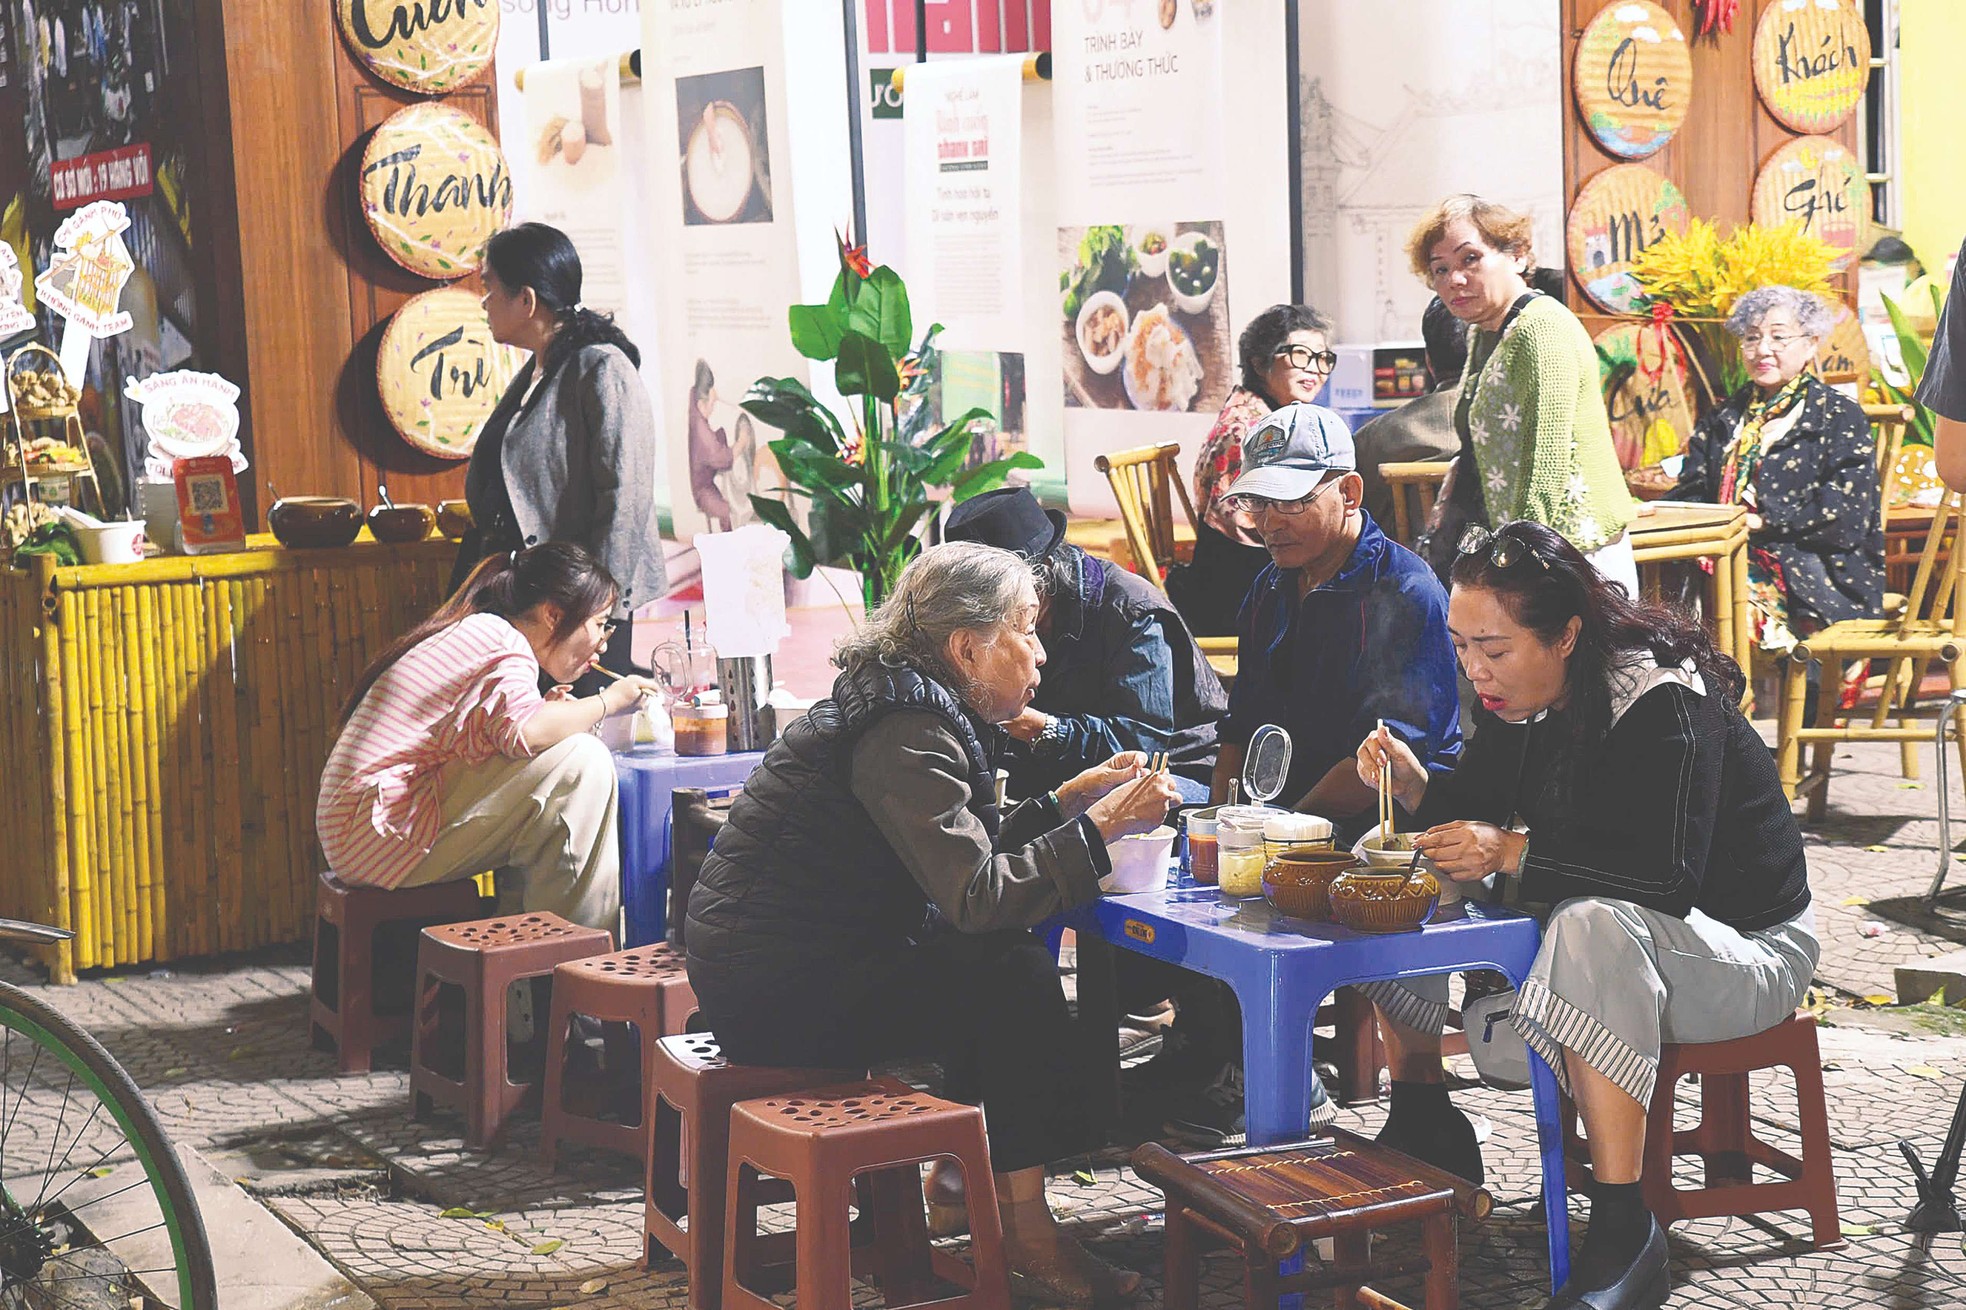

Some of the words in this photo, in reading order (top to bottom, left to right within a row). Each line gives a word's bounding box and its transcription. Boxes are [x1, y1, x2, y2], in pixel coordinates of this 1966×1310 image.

[1775, 21, 1858, 83] Khách
[363, 144, 512, 217] Thanh
[410, 325, 493, 400] Trì
